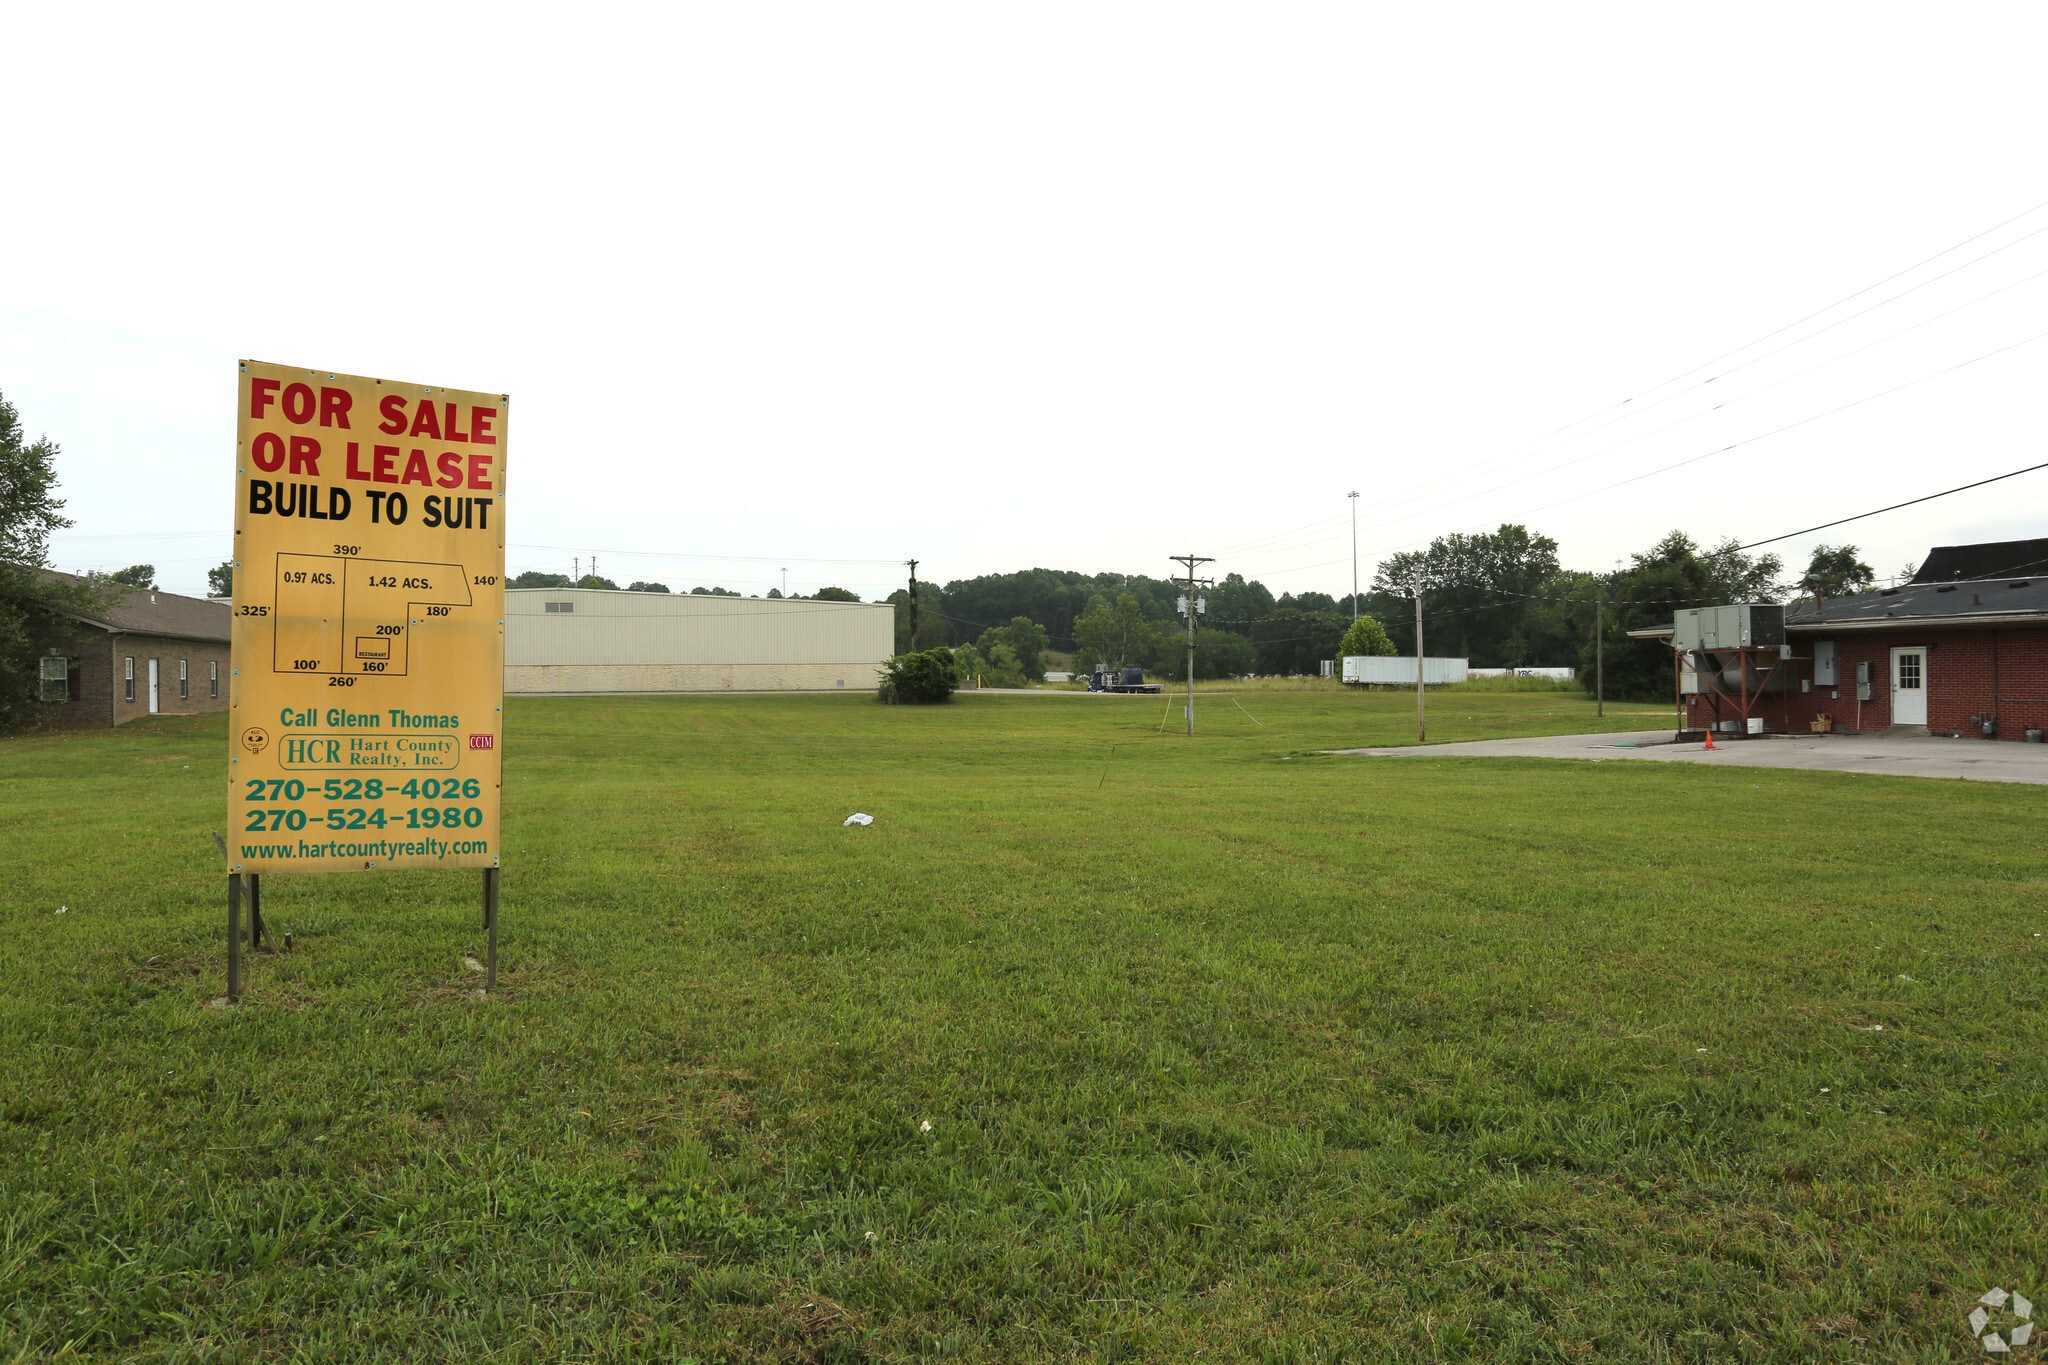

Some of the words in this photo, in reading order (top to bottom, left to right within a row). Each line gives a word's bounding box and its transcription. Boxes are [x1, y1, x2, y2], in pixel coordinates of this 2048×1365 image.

[251, 377, 353, 430] FOR
[377, 394, 497, 445] SALE
[251, 432, 322, 477] OR
[346, 441, 493, 490] LEASE
[249, 479, 351, 521] BUILD
[366, 490, 408, 526] TO
[422, 495, 493, 530] SUIT
[333, 544, 362, 556] 390'
[284, 571, 307, 584] 0.97
[311, 573, 336, 585] ACS.
[368, 576, 397, 588] 1.42
[402, 577, 433, 590] ACS.
[474, 575, 498, 586] 140'
[241, 605, 271, 617] 325'
[426, 606, 452, 617] 180'
[375, 625, 405, 636] 200'
[293, 659, 321, 670] 100'
[362, 661, 389, 672] 160'
[328, 676, 358, 687] 260'
[280, 707, 317, 727] Call
[326, 709, 380, 728] Glenn
[388, 710, 460, 729] Thomas
[350, 738, 389, 752] Hart
[396, 738, 453, 754] County
[469, 735, 493, 749] CCIM
[286, 739, 342, 764] HCR
[350, 752, 407, 768] Realty,
[415, 753, 444, 766] Inc.
[245, 778, 481, 802] 270-528-4026
[245, 807, 483, 832] 270-524-1980
[241, 837, 488, 861] www.hartcountyrealty.com
